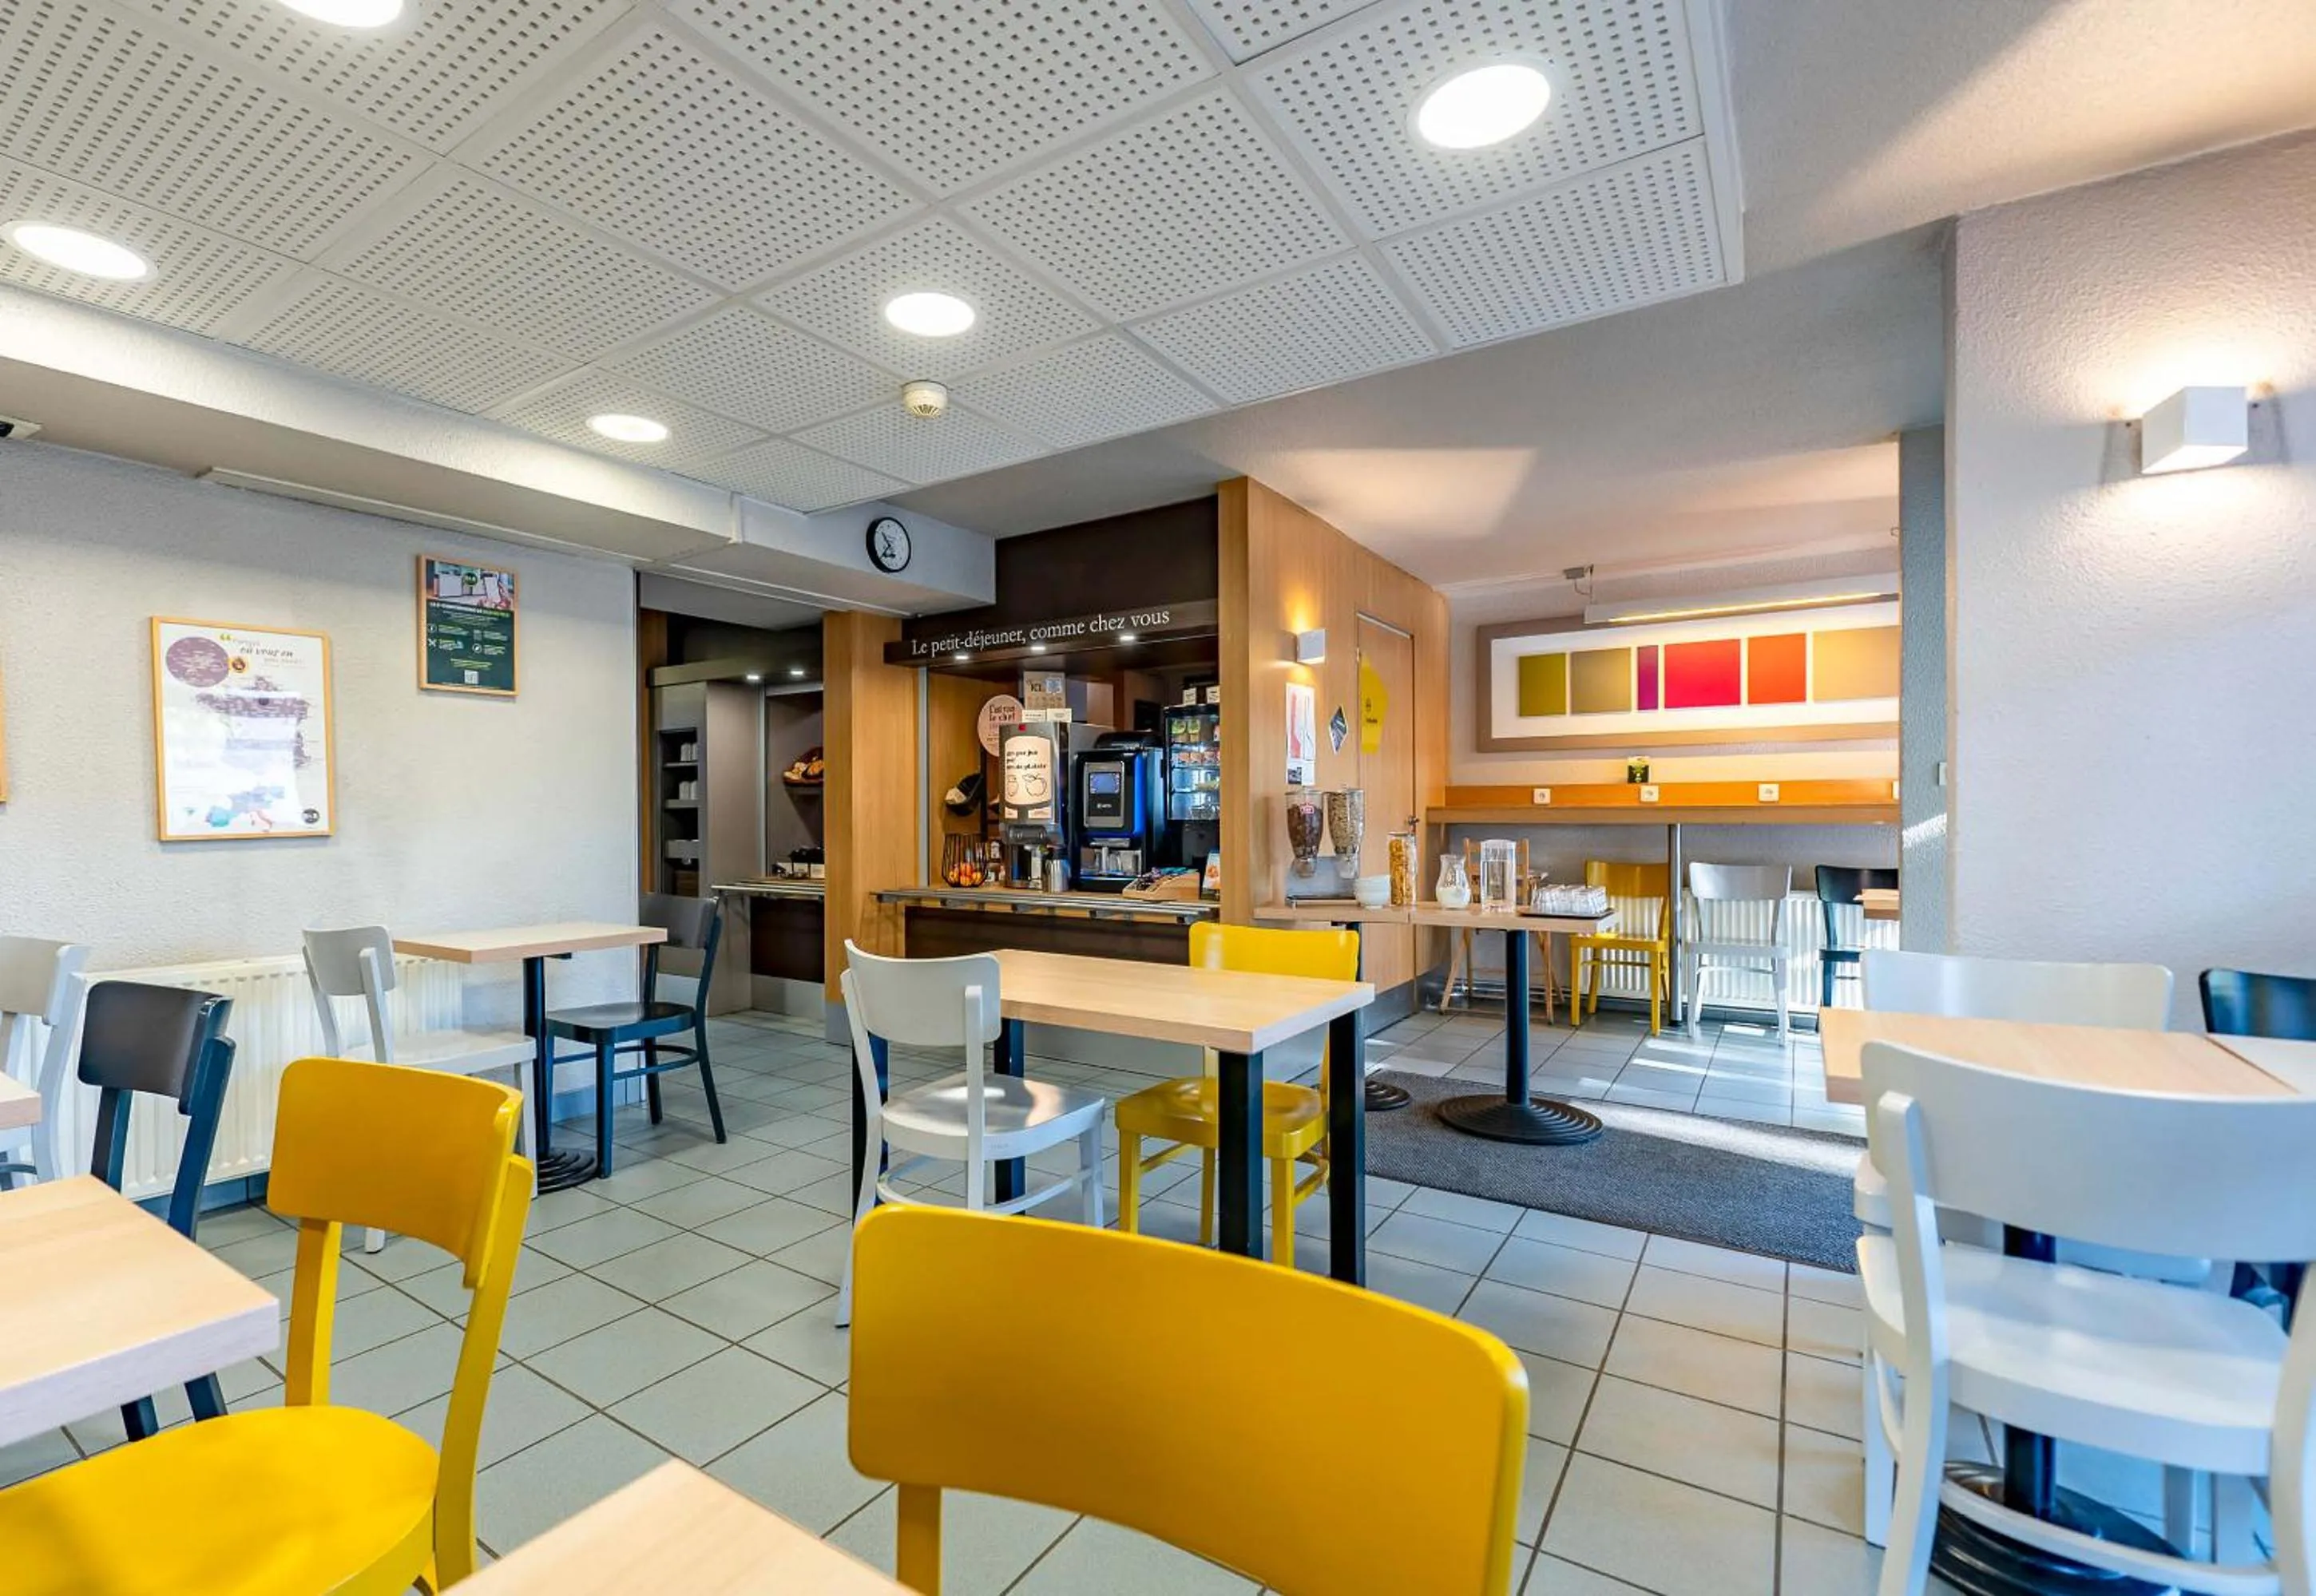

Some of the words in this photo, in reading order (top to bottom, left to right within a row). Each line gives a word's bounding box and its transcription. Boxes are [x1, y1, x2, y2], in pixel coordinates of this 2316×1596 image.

[910, 639, 928, 655] Le
[931, 629, 1025, 659] petit-déjeuner,
[1029, 622, 1085, 640] comme
[1089, 614, 1125, 632] chez
[1130, 610, 1170, 627] vous
